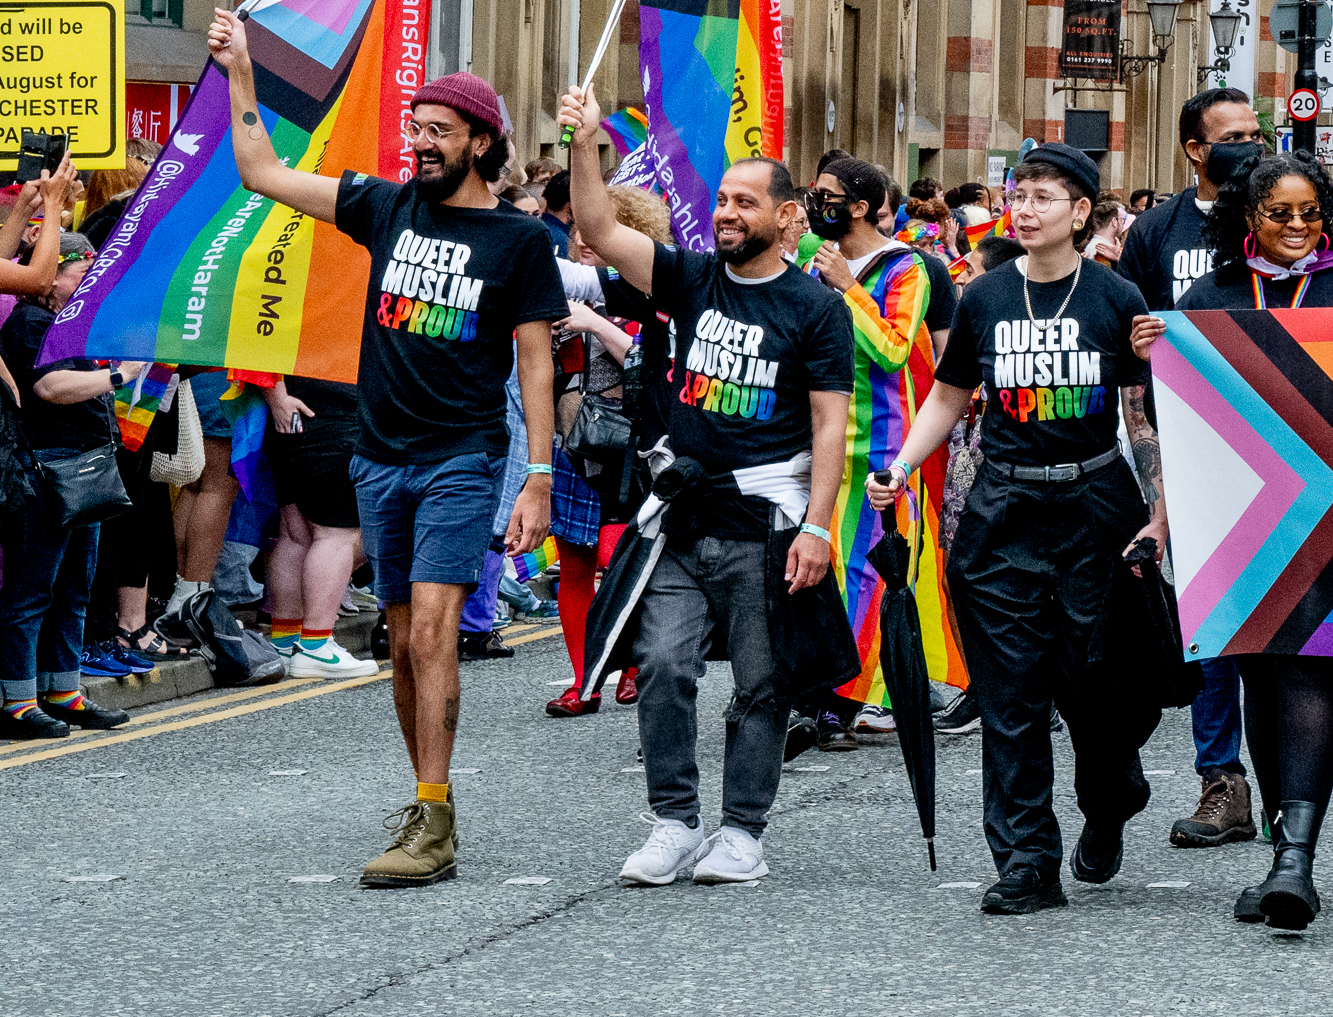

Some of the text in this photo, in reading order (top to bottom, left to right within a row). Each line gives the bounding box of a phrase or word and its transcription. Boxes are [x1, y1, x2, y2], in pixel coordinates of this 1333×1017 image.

[19, 18, 52, 34] will
[60, 18, 83, 34] be
[1077, 16, 1106, 25] FROM
[69, 72, 98, 88] for
[1293, 98, 1316, 111] 20
[264, 209, 306, 286] reated
[392, 229, 472, 276] QUEER
[381, 260, 484, 312] MUSLIM
[256, 294, 283, 337] Me
[695, 308, 764, 357] QUEER
[994, 318, 1080, 353] QUEER
[685, 337, 779, 389] MUSLIM
[994, 351, 1101, 388] MUSLIM
